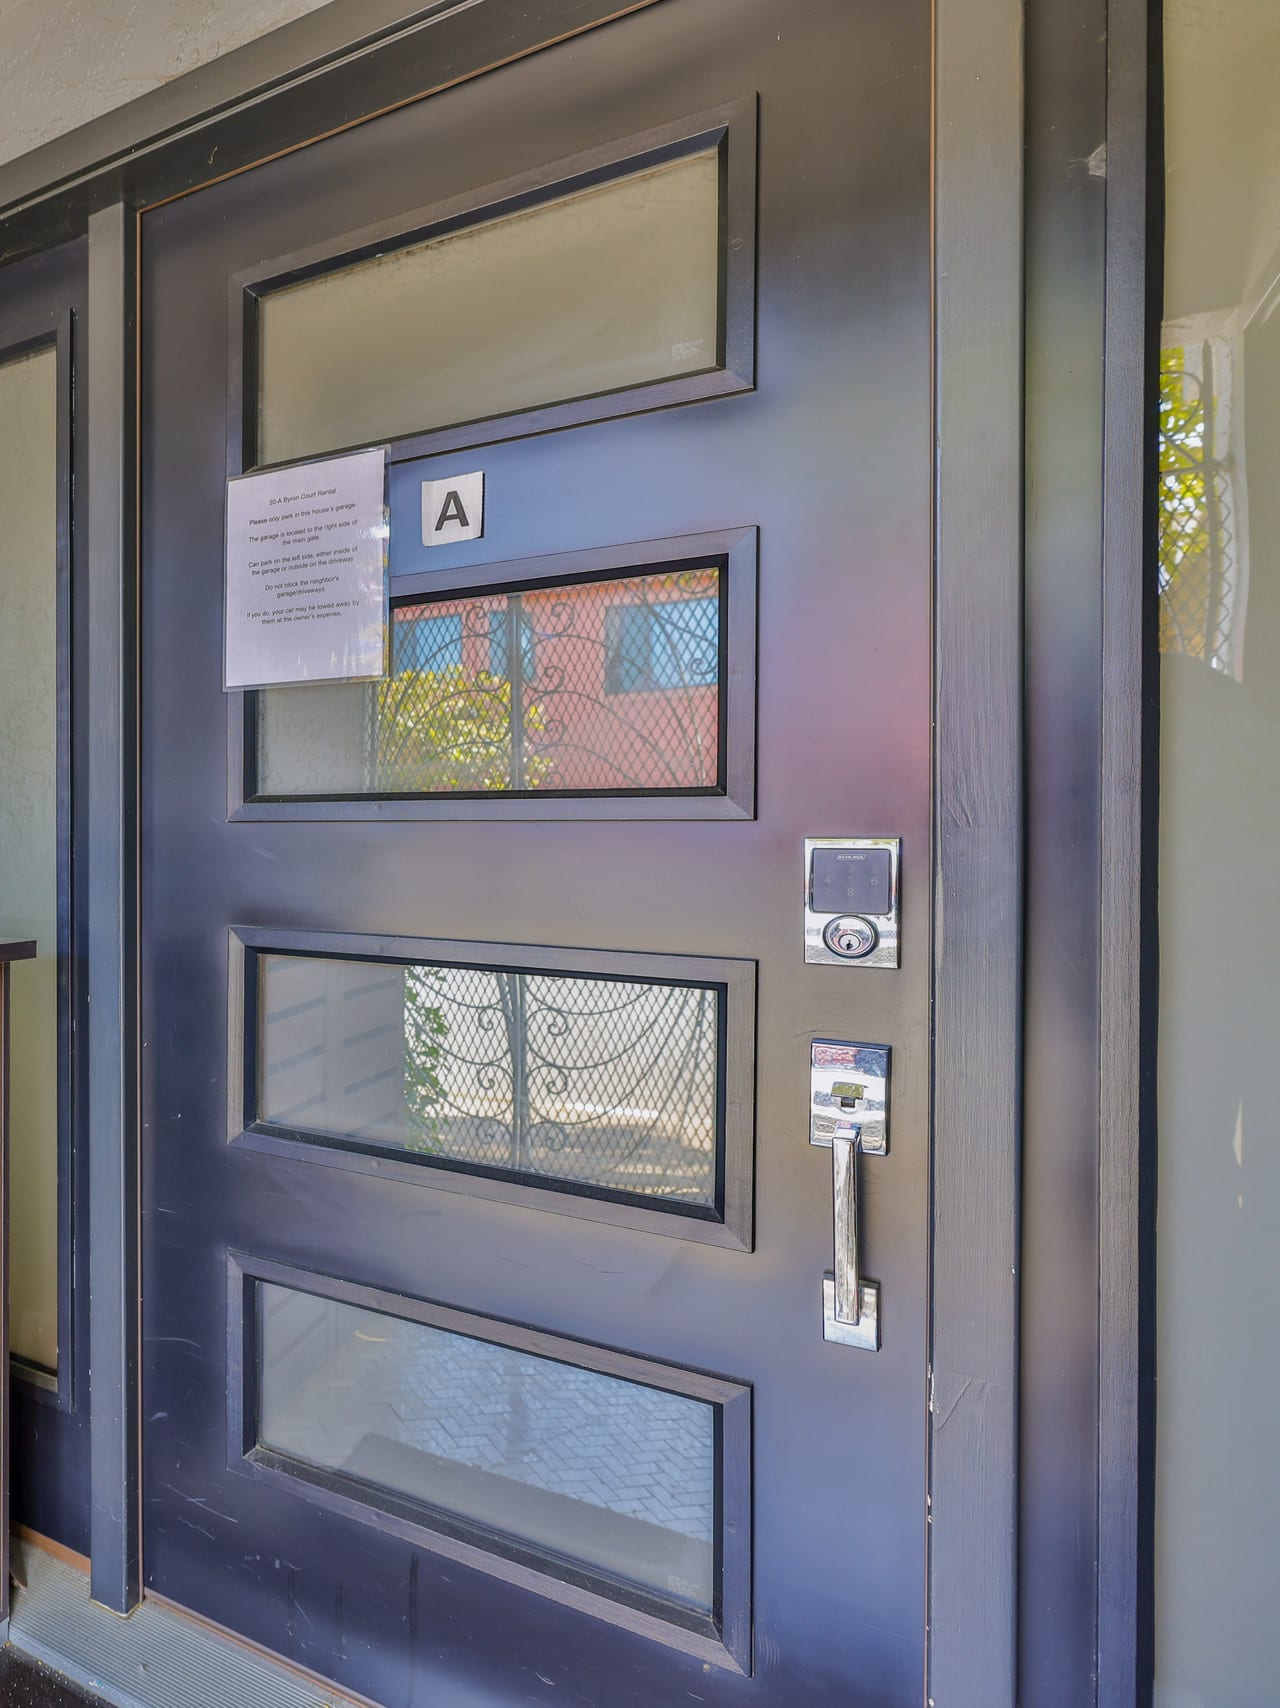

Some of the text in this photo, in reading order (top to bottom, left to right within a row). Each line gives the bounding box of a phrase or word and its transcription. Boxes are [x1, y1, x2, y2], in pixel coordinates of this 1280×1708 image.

[283, 496, 300, 504] Byron
[300, 492, 316, 500] Court
[317, 488, 336, 496] Rental
[249, 518, 268, 526] Please
[268, 516, 280, 524] only
[281, 513, 294, 521] park
[312, 506, 334, 514] house's
[434, 490, 469, 532] A
[260, 533, 279, 542] garage
[286, 527, 306, 536] located
[324, 522, 337, 531] right
[260, 559, 272, 568] park
[333, 547, 350, 555] inside
[261, 567, 280, 576] garage
[288, 562, 308, 570] outside
[310, 576, 340, 585] neighbor's
[316, 602, 334, 610] towed
[352, 600, 360, 608] by
[294, 614, 315, 622] owner's
